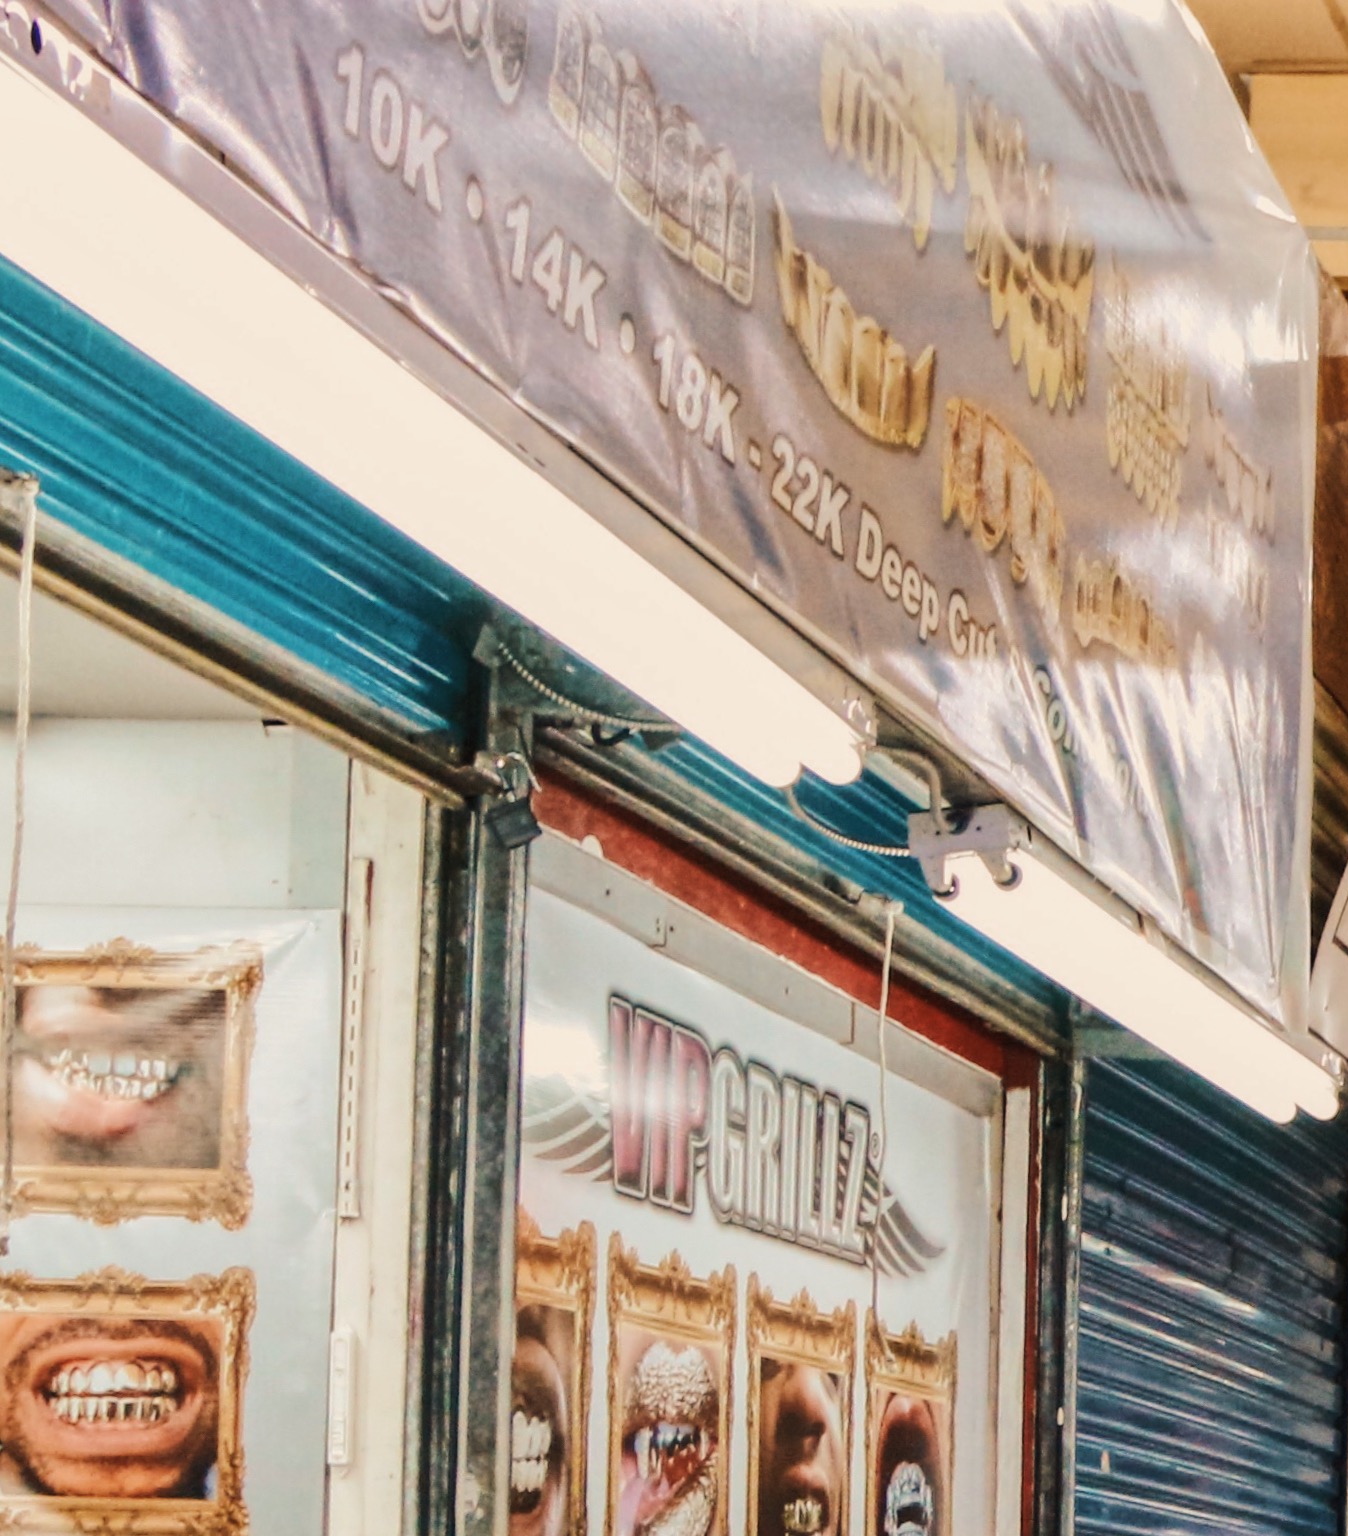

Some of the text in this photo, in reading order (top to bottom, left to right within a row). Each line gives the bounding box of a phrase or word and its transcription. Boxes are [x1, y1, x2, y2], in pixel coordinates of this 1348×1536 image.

[334, 41, 449, 214] 10K
[504, 194, 607, 349] 14K
[652, 332, 742, 467] 18K
[769, 431, 850, 569] 22K
[855, 505, 944, 647] Deep
[607, 988, 870, 1266] VIP GRILLZ
